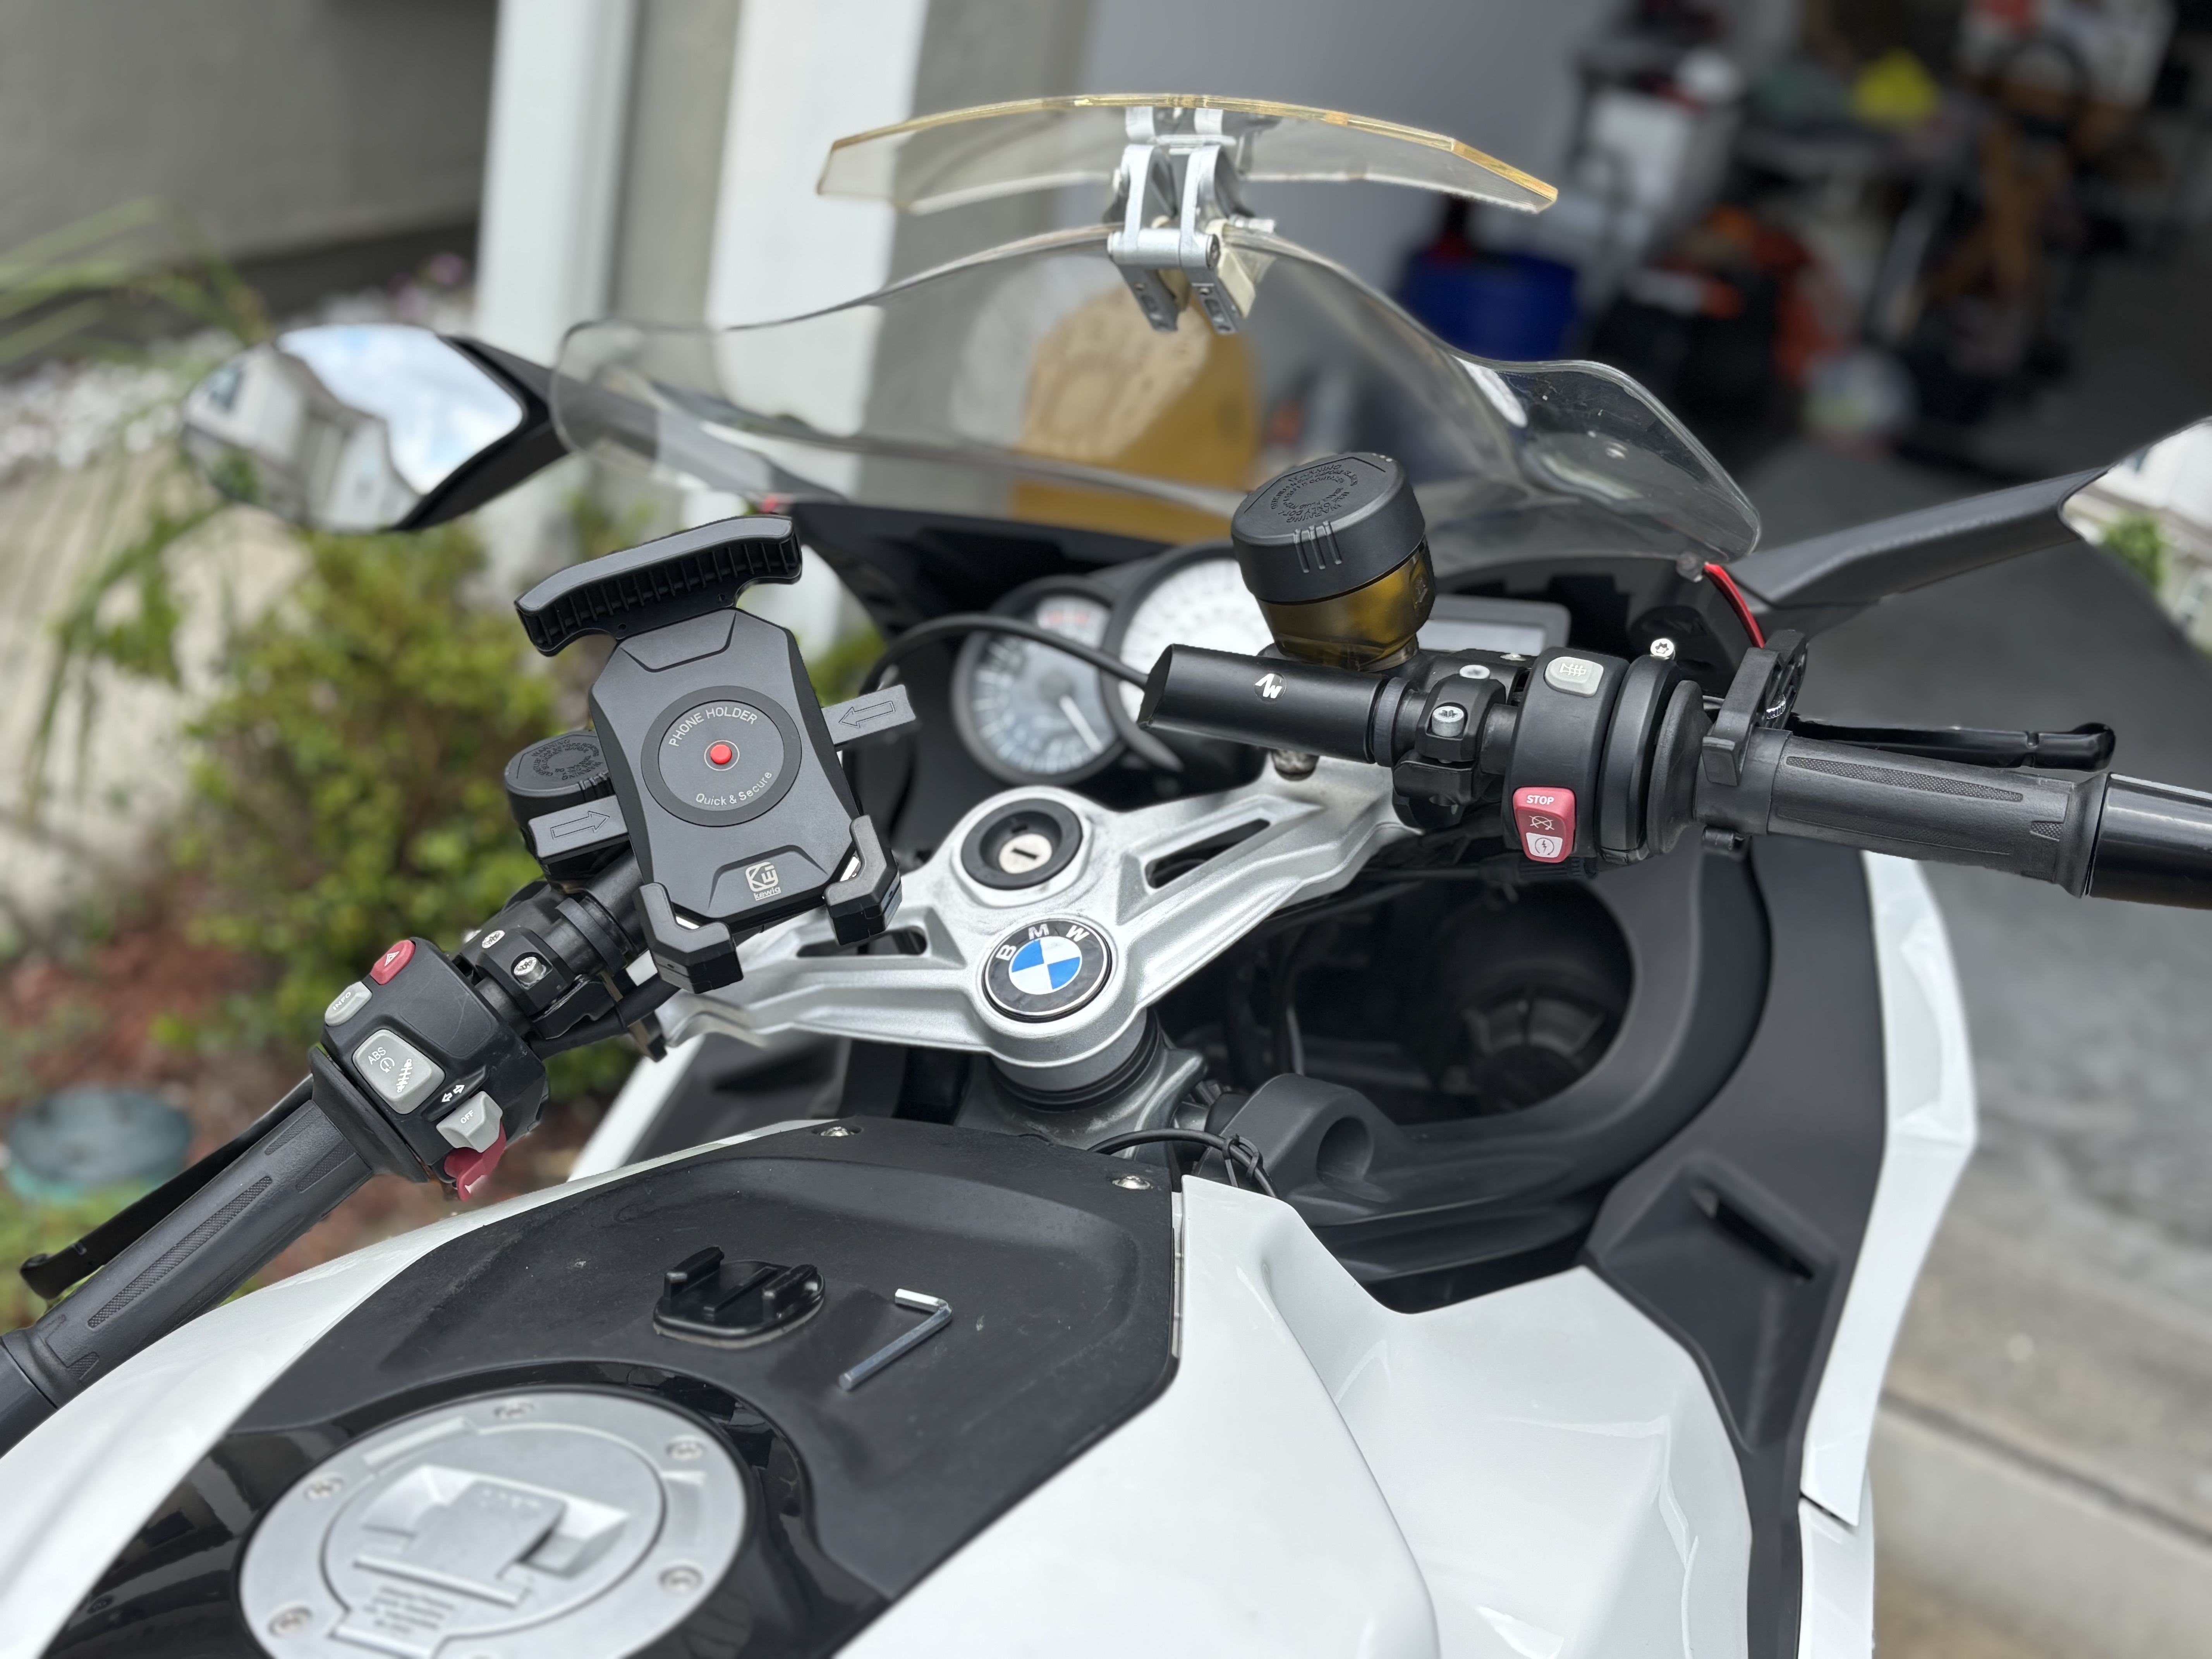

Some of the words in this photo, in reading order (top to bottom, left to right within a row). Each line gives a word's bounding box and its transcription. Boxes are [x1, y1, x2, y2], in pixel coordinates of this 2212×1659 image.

[668, 713, 704, 746] PHONE
[706, 707, 757, 724] HOLDER
[696, 793, 727, 805] Quick
[729, 795, 737, 804] &
[738, 772, 772, 800] Secure
[1526, 795, 1554, 805] STOP
[996, 924, 1090, 961] BMW
[333, 992, 351, 1010] INFO
[368, 1047, 386, 1065] ABS
[460, 1110, 474, 1123] OFF
